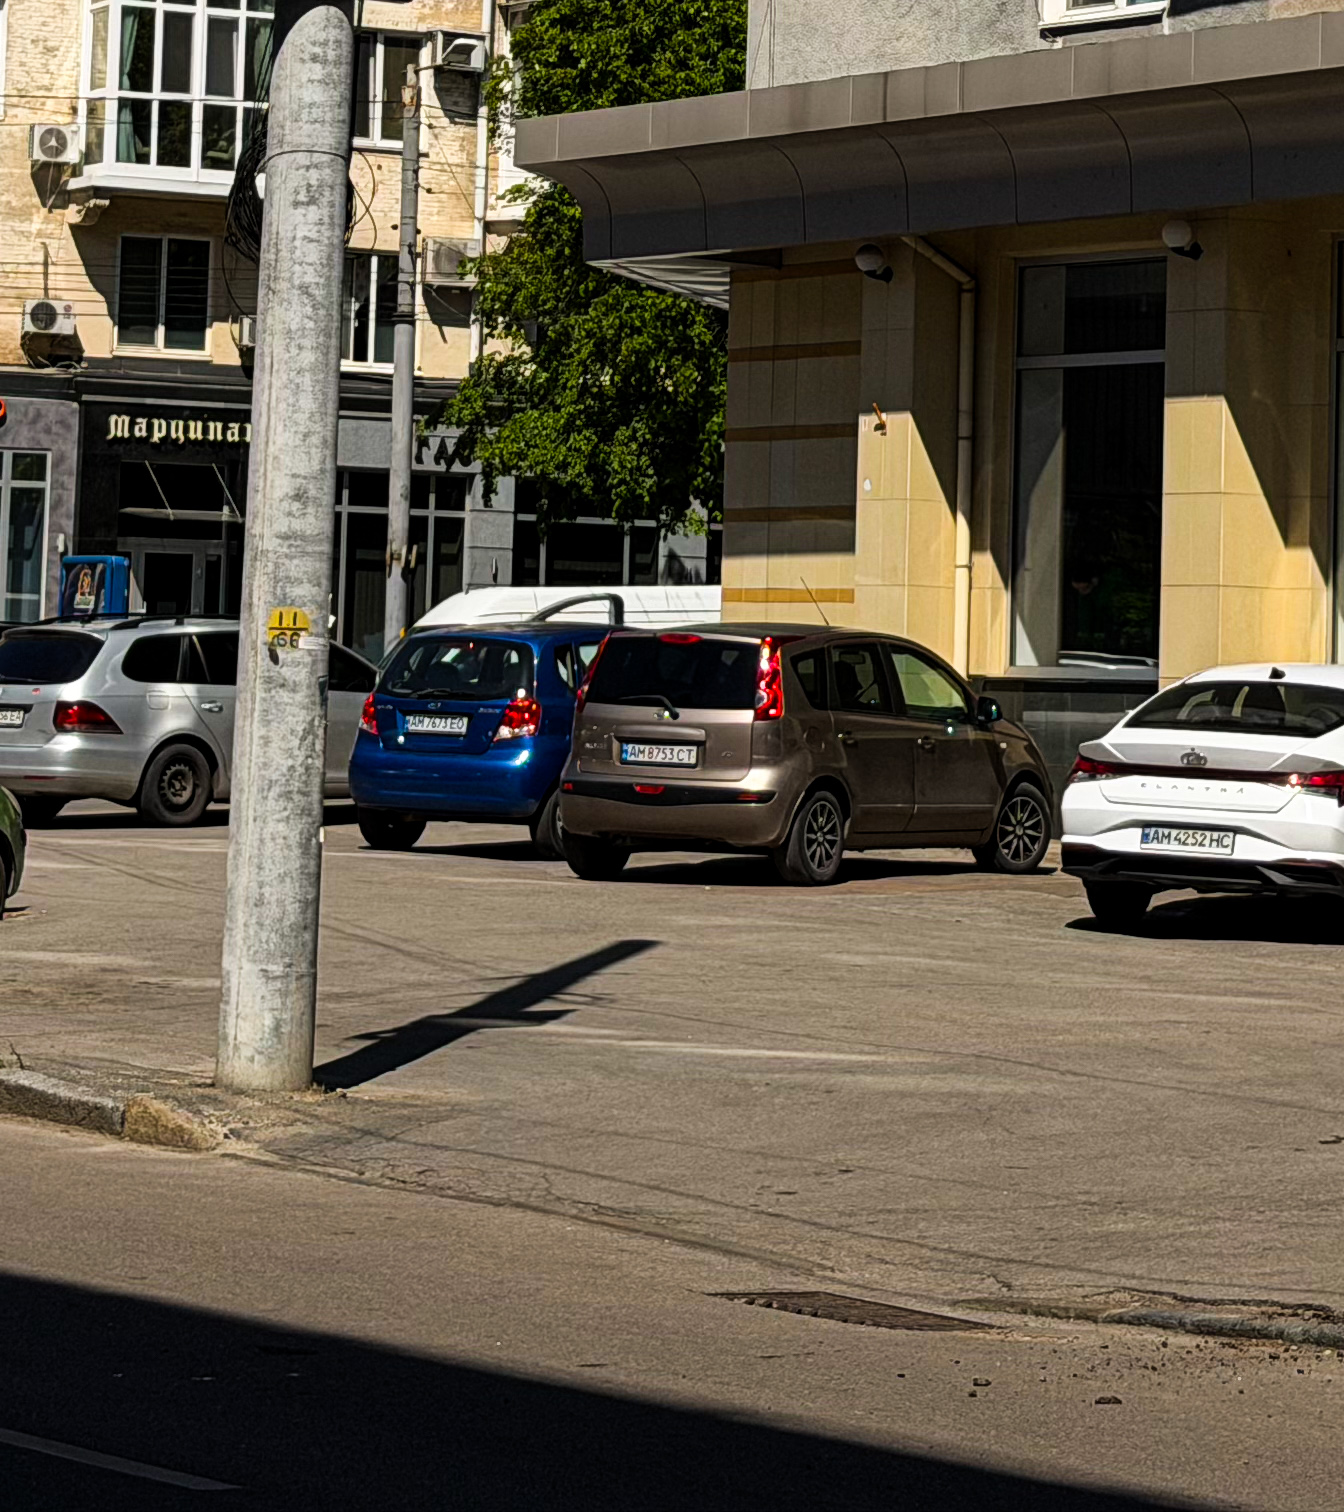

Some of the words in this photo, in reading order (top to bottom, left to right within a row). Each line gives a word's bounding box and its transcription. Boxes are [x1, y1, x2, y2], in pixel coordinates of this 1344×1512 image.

[628, 745, 646, 759] AM
[647, 746, 675, 761] 8753
[676, 748, 695, 762] CT
[1150, 829, 1172, 845] AM
[1173, 831, 1208, 847] 4252
[1208, 832, 1232, 849] HC
